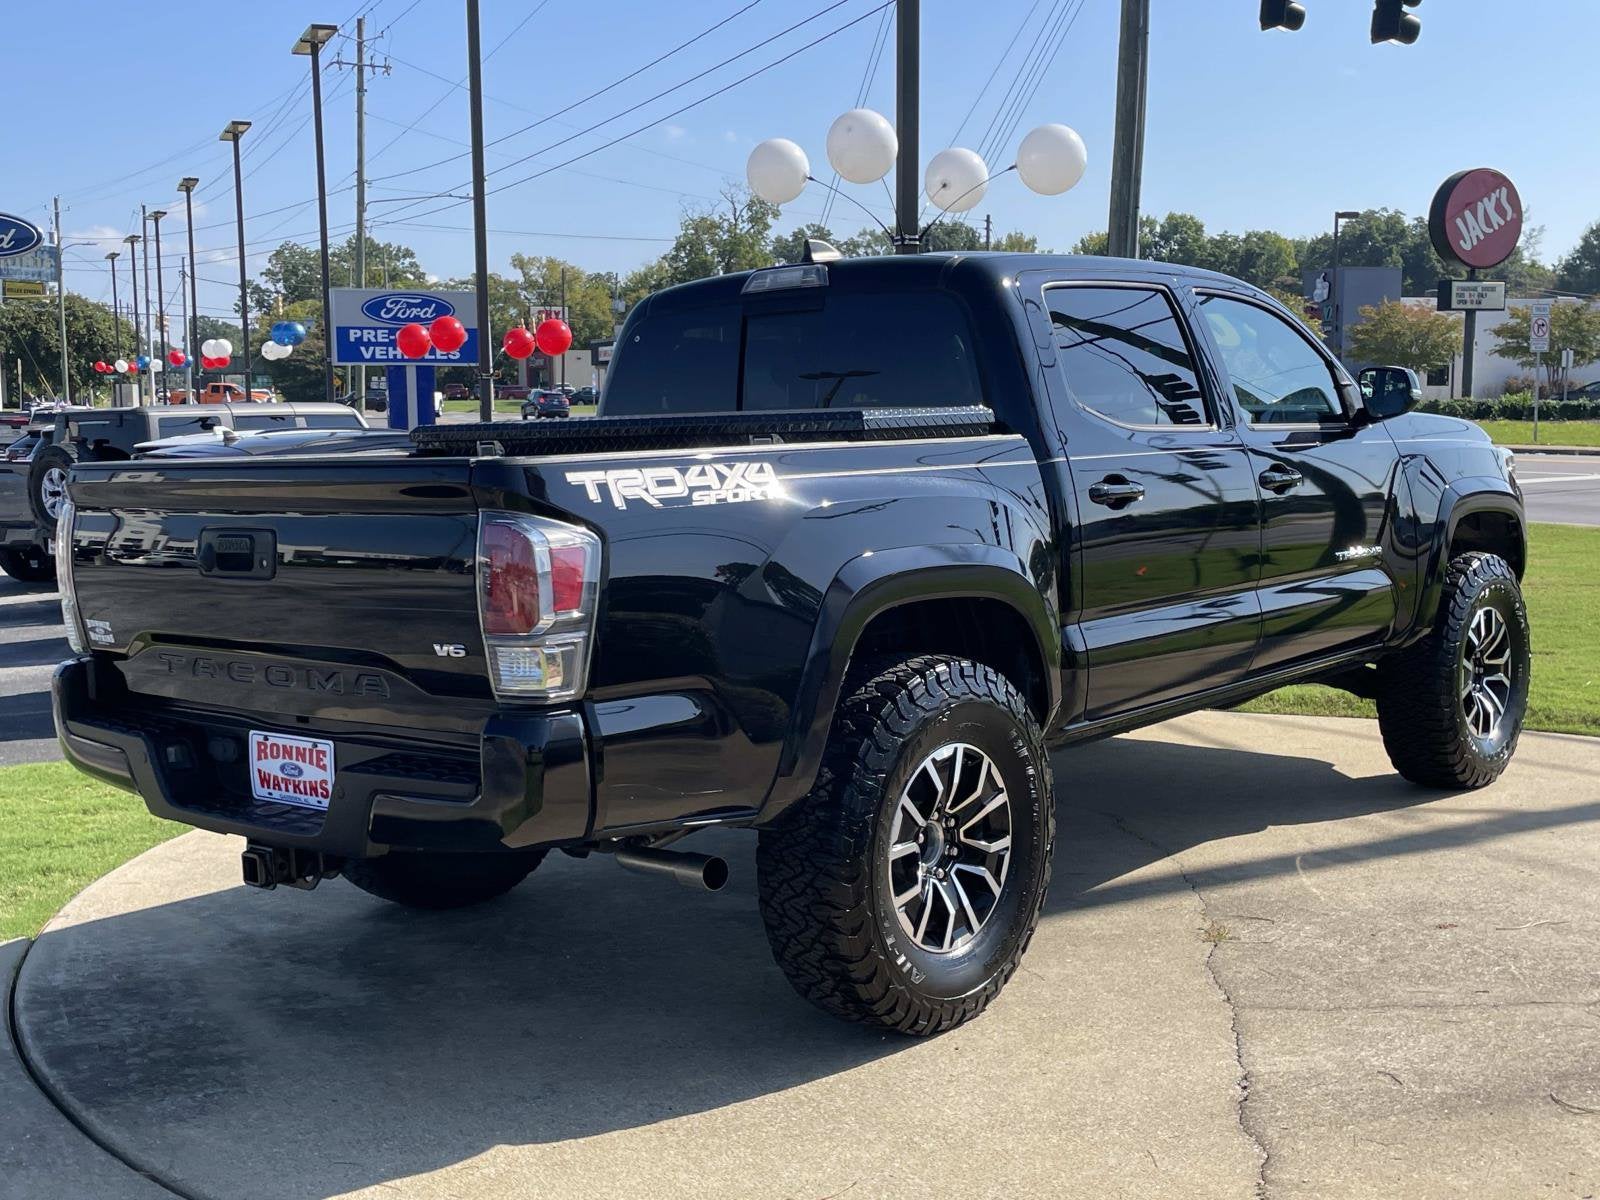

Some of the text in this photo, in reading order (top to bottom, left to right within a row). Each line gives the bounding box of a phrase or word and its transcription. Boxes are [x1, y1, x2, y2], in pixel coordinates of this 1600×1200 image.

[1456, 187, 1512, 250] JACK'S
[380, 298, 436, 319] Ford
[360, 346, 461, 360] VEHLES
[565, 466, 688, 510] TRD
[433, 643, 466, 658] V6
[158, 652, 391, 699] TACOMA
[256, 741, 327, 772] RONNIE
[257, 768, 330, 799] WATKINS
